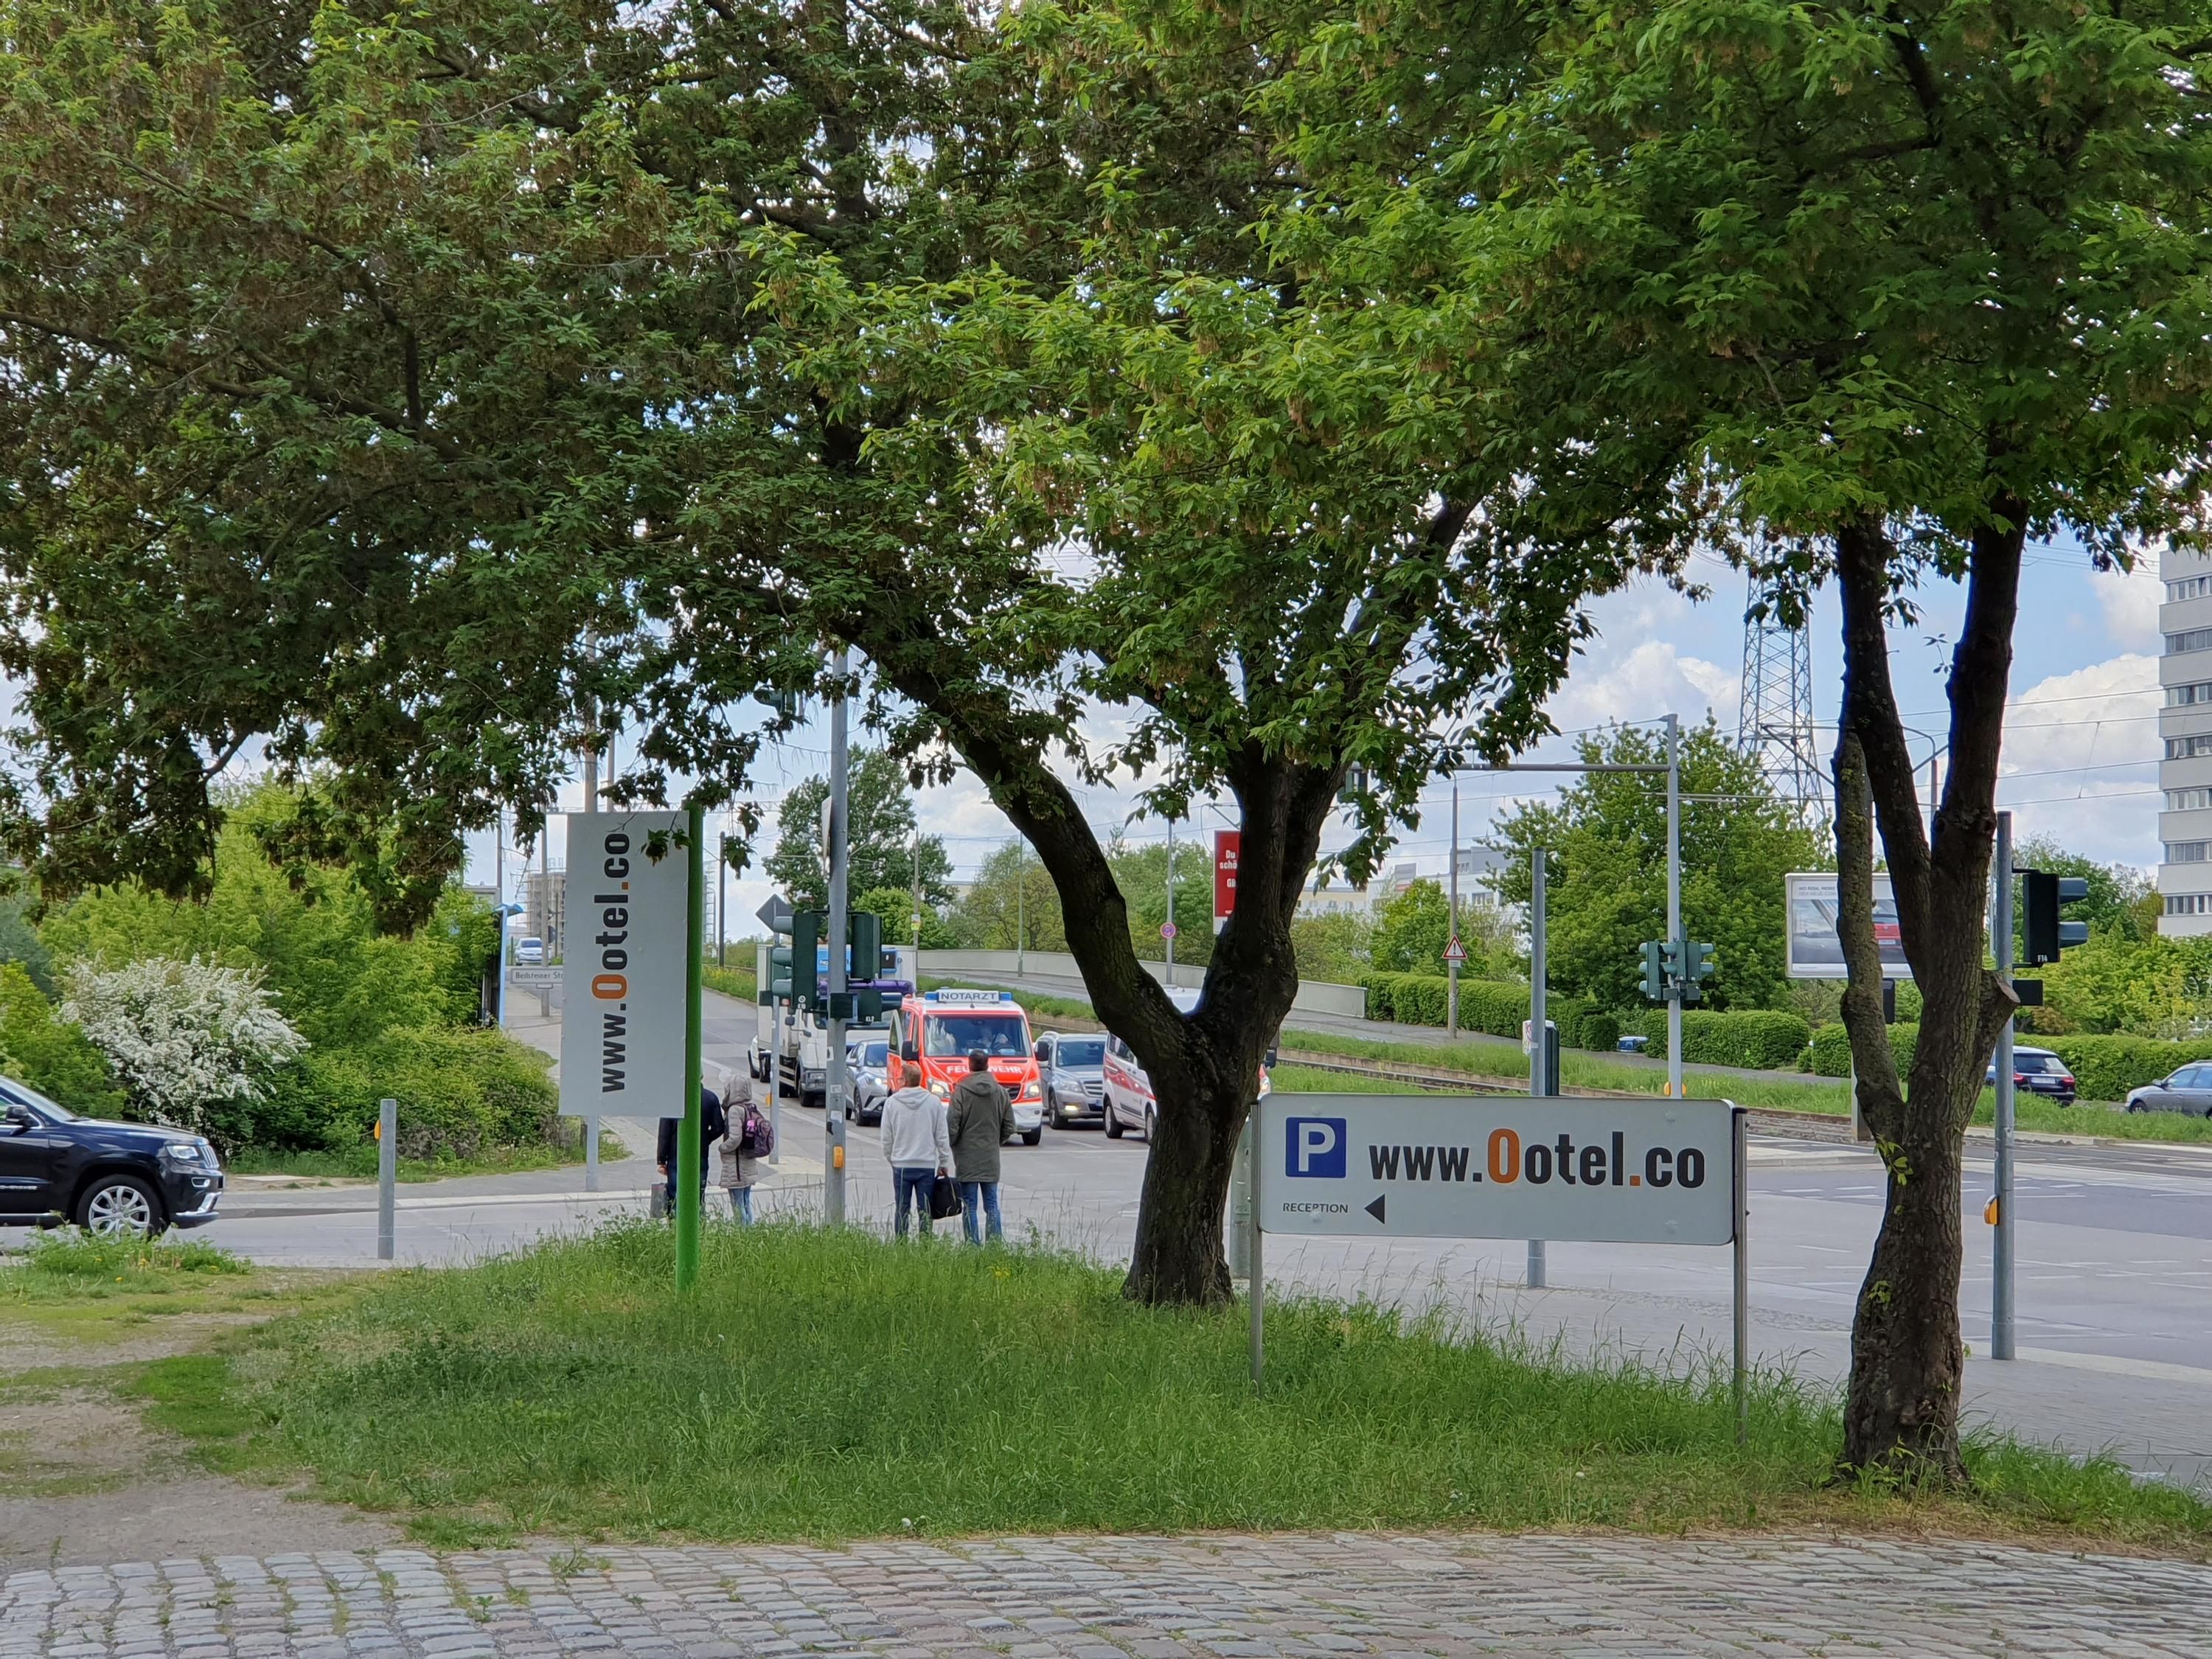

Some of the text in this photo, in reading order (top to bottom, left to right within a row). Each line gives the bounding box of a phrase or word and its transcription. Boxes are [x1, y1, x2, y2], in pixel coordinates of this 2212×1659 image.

[1225, 849, 1236, 859] Du
[1219, 860, 1238, 869] schö
[591, 832, 630, 1093] www.Ootel.co
[946, 1065, 1023, 1074] FEUWEHR
[1298, 1121, 1336, 1172] P
[1368, 1127, 1705, 1189] www.Ootel.co
[1282, 1203, 1349, 1213] RECEPTION
